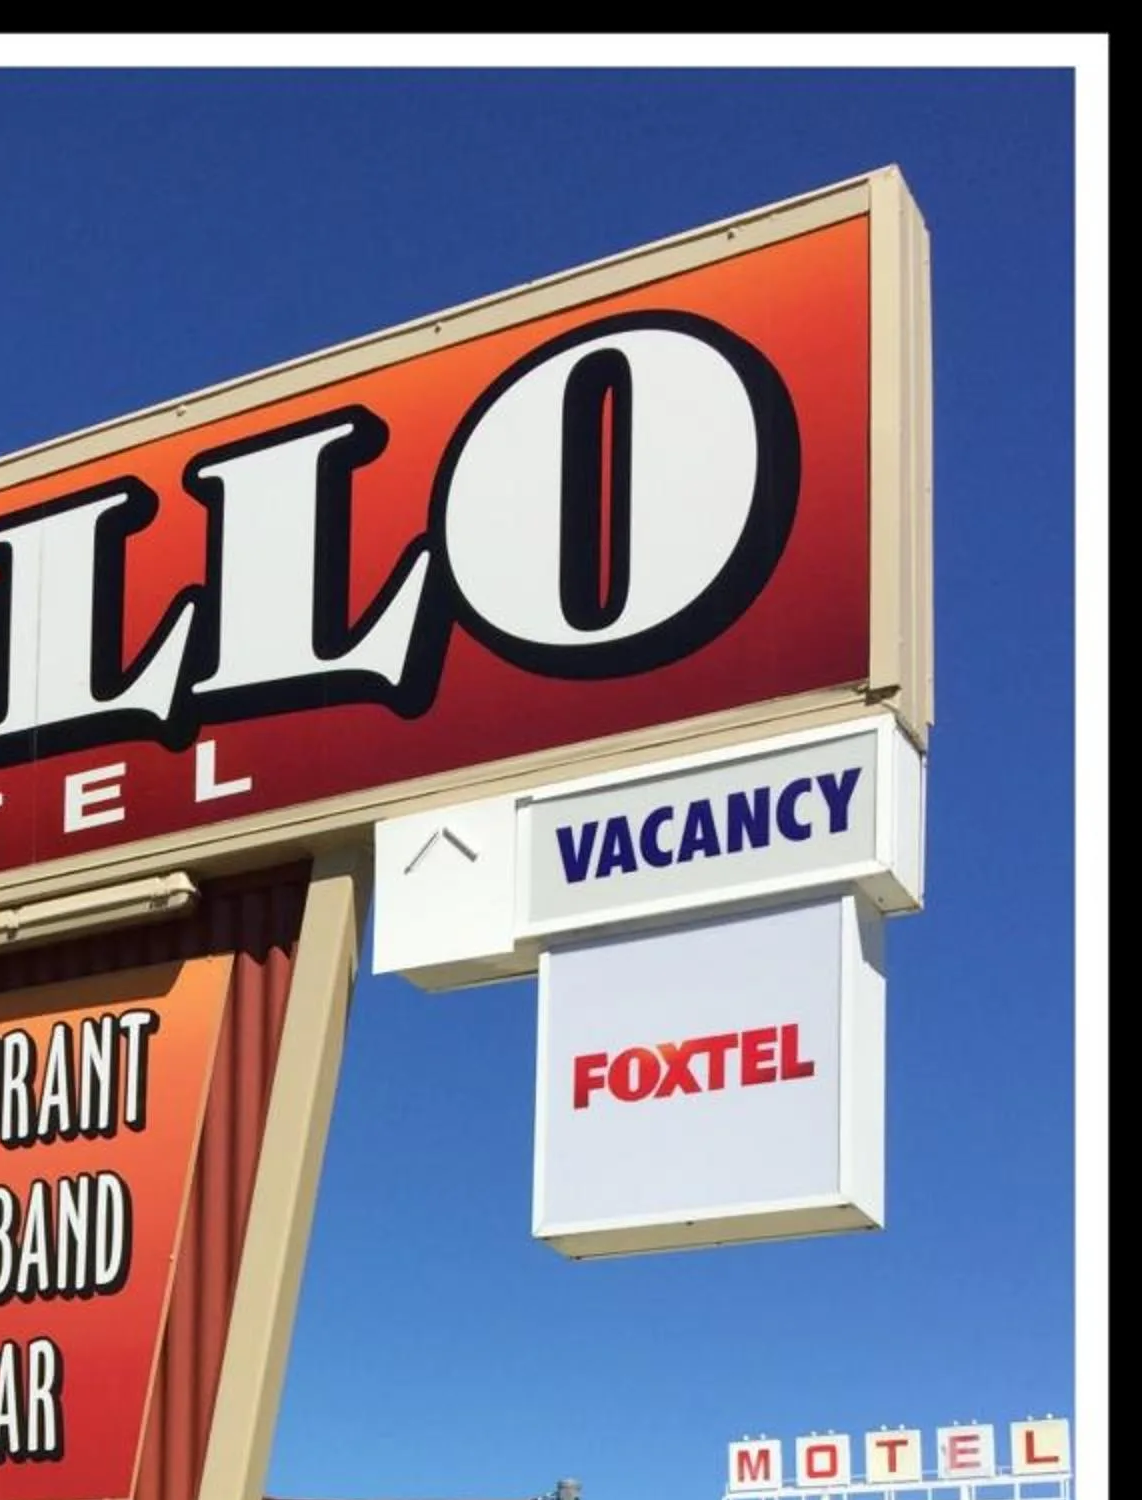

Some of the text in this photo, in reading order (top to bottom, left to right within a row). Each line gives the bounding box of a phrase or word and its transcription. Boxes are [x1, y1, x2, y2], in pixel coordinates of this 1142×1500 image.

[555, 767, 863, 884] VACANCY
[572, 1023, 815, 1110] FOXTEL
[736, 1429, 1060, 1483] MOTEL
